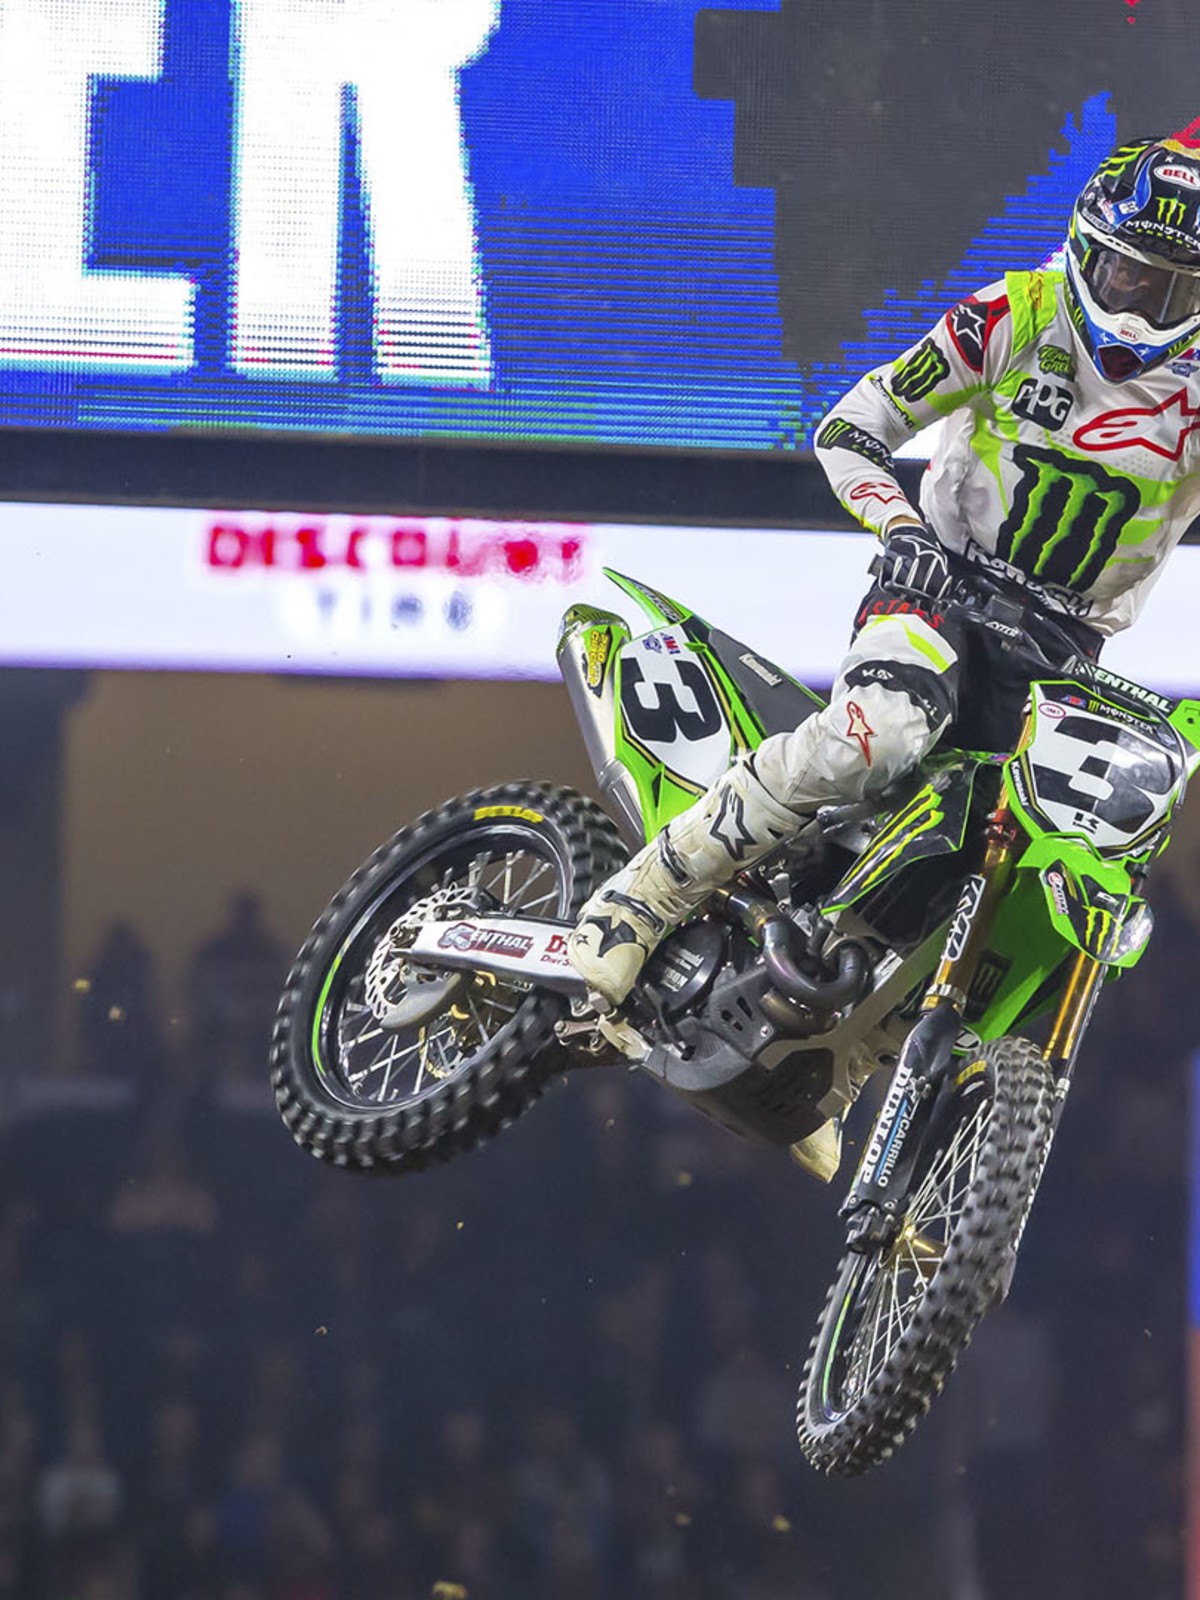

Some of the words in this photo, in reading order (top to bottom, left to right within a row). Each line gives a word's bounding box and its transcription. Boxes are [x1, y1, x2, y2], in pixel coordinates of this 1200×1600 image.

[1163, 168, 1197, 184] BELL
[1015, 384, 1072, 421] PPG
[620, 657, 722, 743] 3
[1031, 716, 1176, 834] 3
[878, 1119, 911, 1188] CARRILLO
